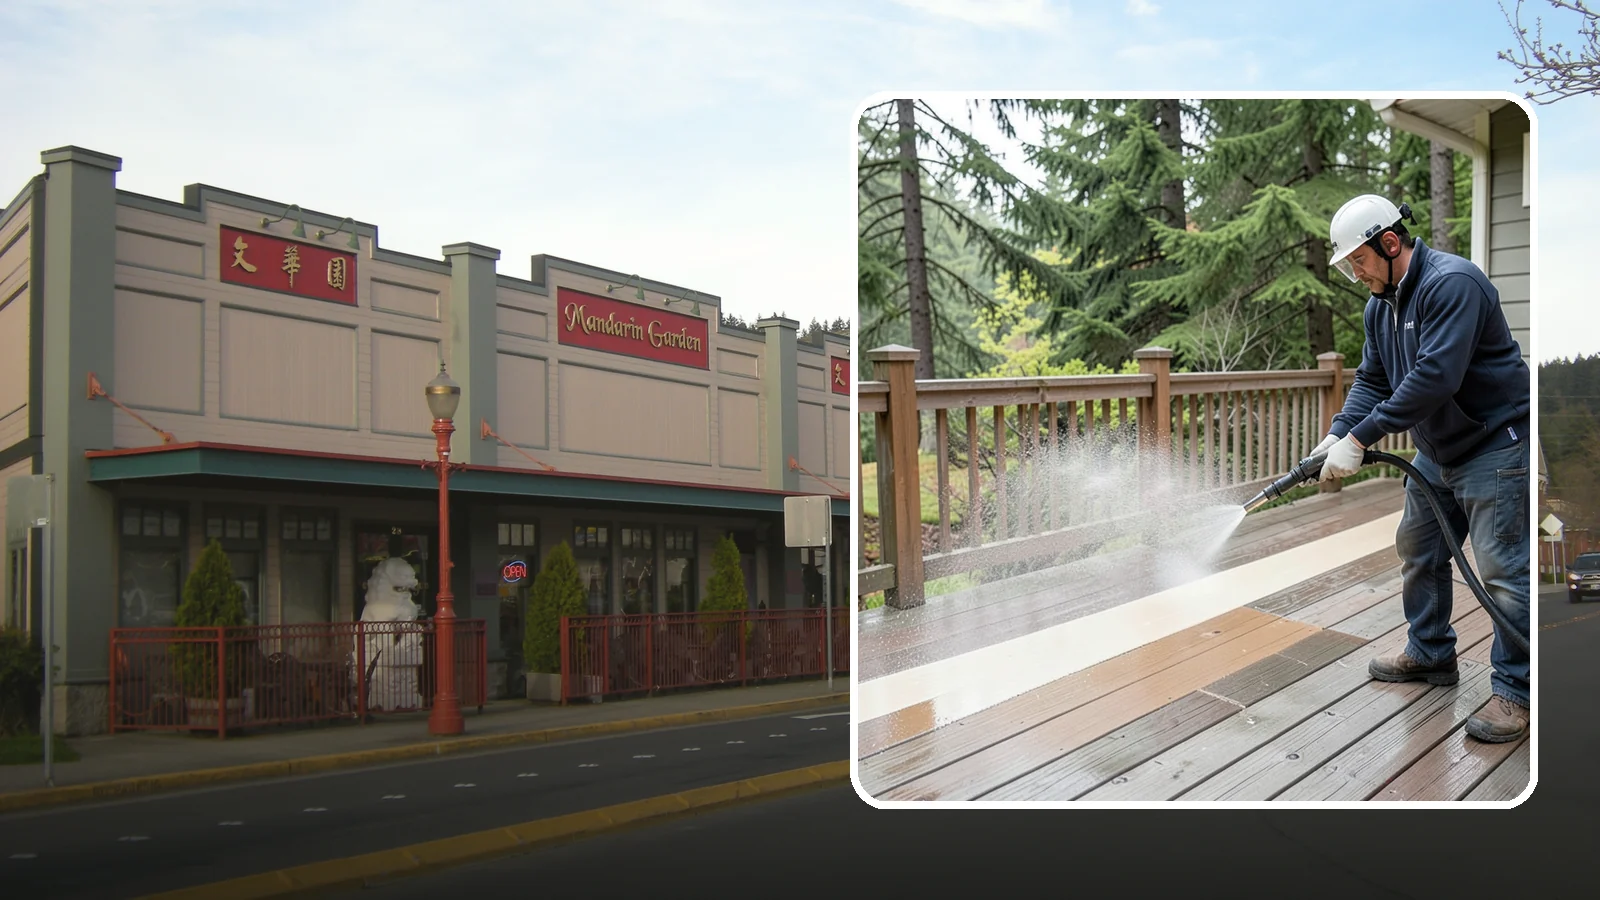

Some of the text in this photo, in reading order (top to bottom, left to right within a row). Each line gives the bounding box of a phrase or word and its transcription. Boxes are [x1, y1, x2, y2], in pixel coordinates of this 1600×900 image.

[230, 235, 347, 291] 文華園
[564, 302, 702, 352] Mandarin Garden
[503, 565, 527, 578] OPEN
